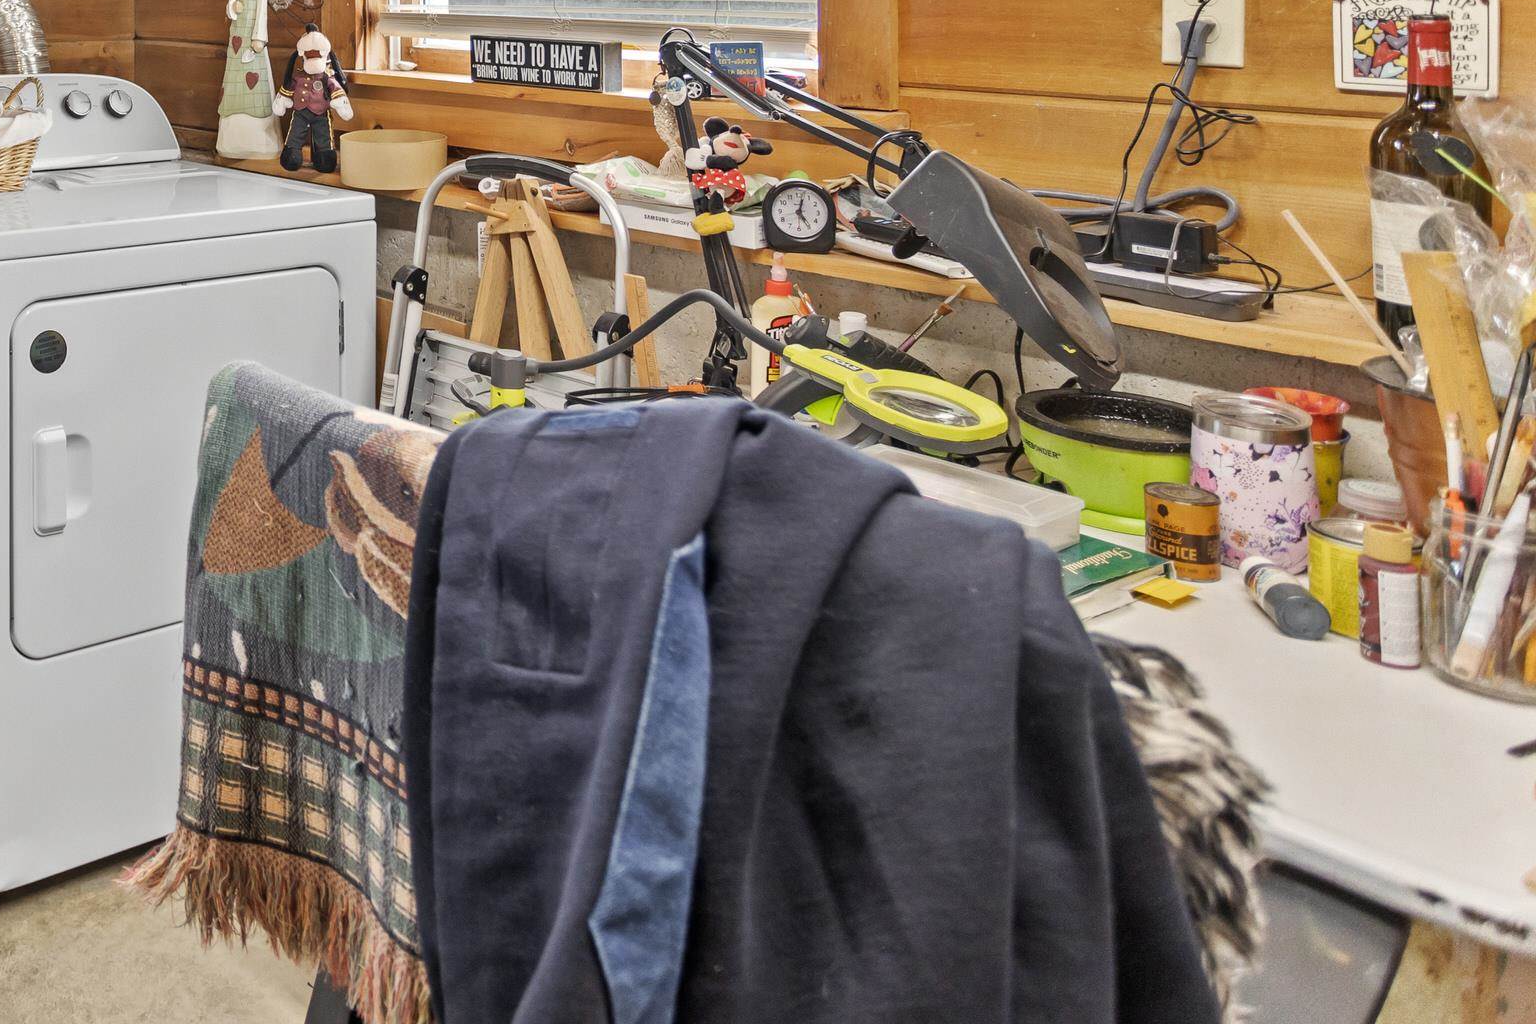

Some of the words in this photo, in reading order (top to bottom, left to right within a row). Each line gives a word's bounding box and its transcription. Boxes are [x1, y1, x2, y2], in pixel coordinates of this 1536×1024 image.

[473, 39, 491, 63] WE
[495, 41, 525, 66] NEED
[529, 43, 545, 68] TO
[550, 44, 584, 71] HAVE
[588, 46, 598, 72] A
[499, 66, 518, 81] YOUR
[521, 68, 539, 83] WINE
[542, 69, 551, 84] TO
[554, 71, 576, 86] WORK
[643, 213, 669, 223] SAMSUNG
[670, 218, 690, 227] Galaxy
[1148, 534, 1198, 562] LLSPICE
